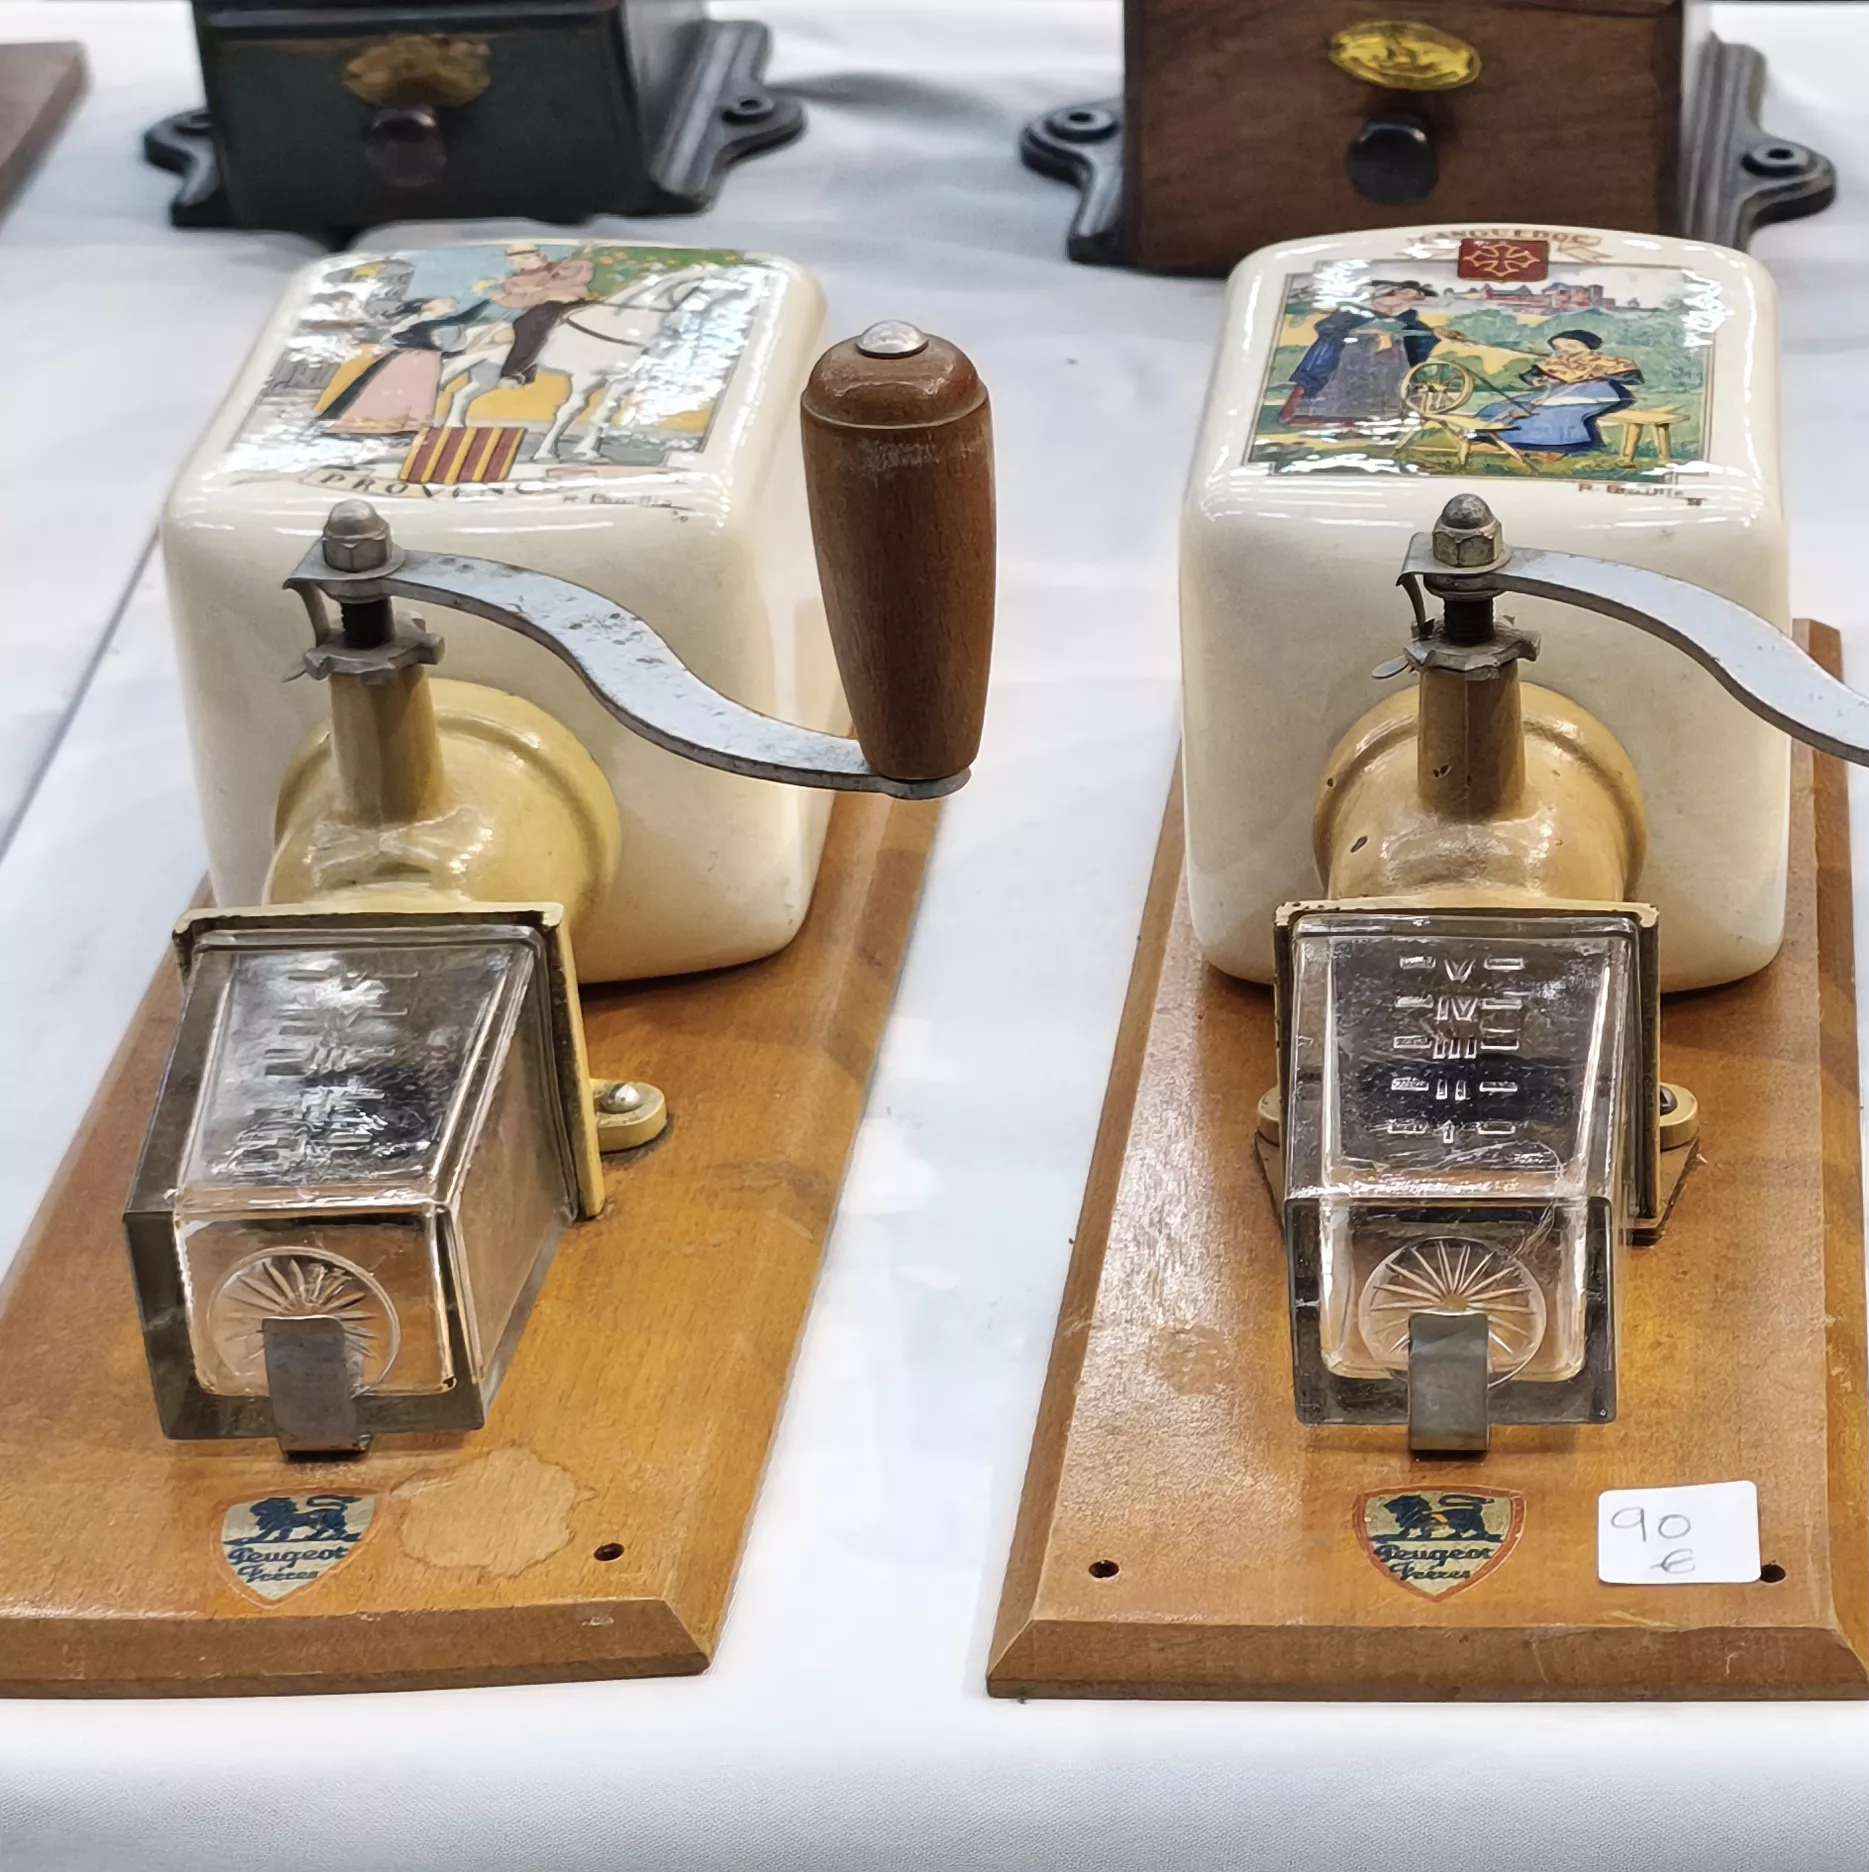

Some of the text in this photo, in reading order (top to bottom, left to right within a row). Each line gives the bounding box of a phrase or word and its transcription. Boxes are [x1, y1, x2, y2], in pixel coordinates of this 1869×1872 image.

[319, 471, 545, 498] PROVENC
[1611, 1506, 1692, 1543] 90
[227, 1546, 350, 1572] Peugeot
[1373, 1544, 1496, 1567] Peugeot
[1649, 1548, 1696, 1575] €
